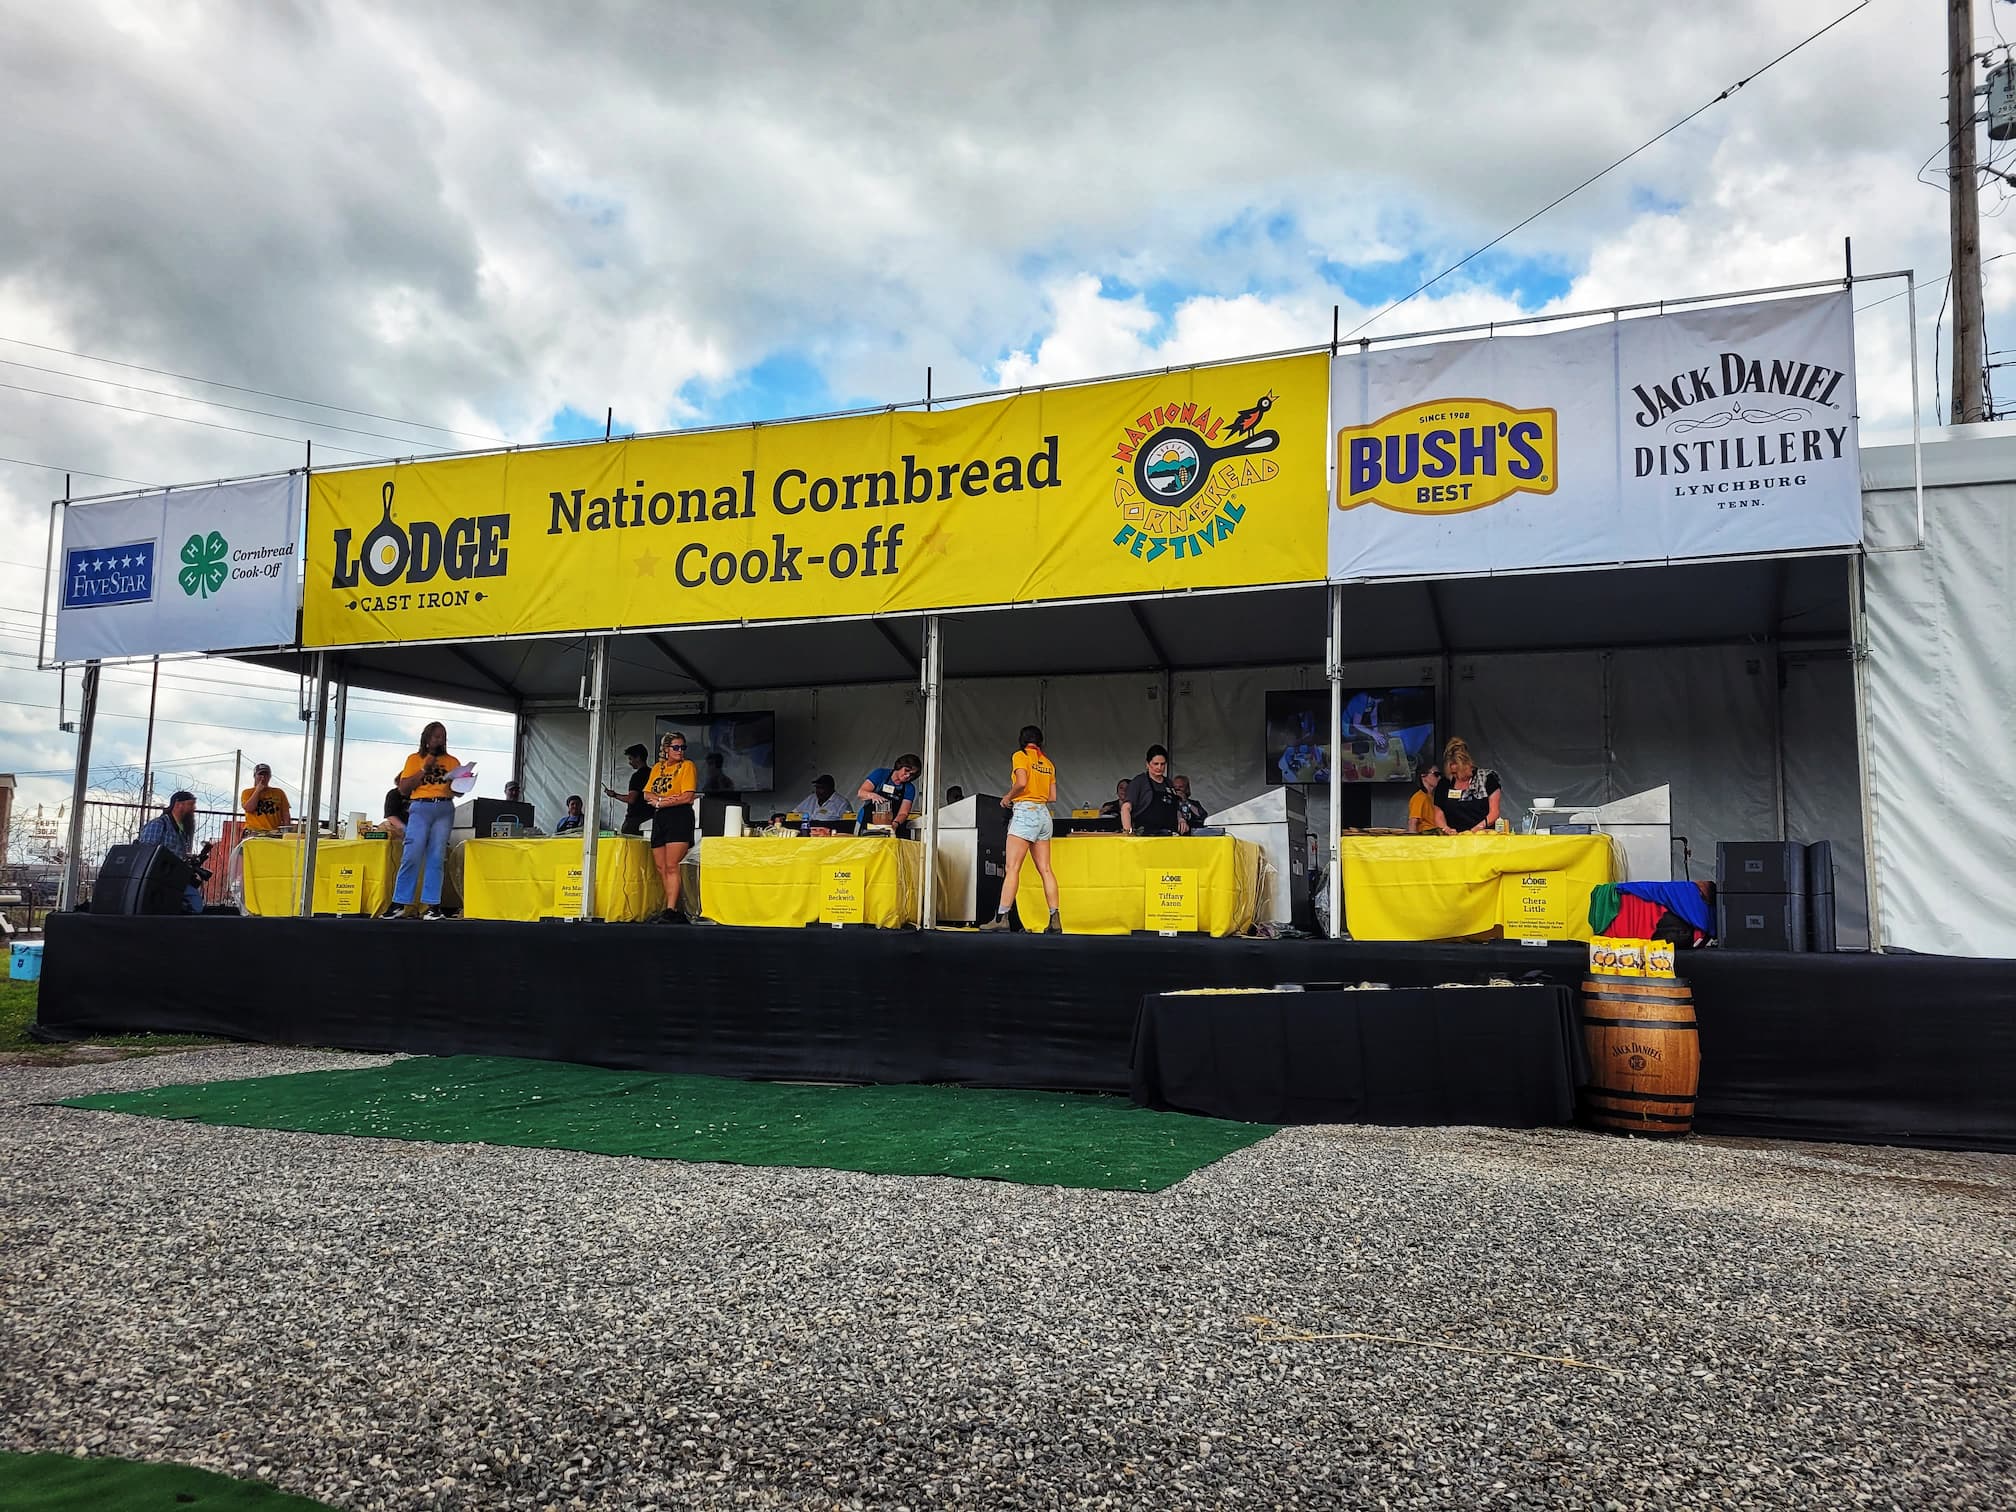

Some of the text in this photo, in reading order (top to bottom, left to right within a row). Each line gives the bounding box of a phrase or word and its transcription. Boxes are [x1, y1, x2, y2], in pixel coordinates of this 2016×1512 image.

[1631, 352, 1846, 428] JACK DANIEL
[1419, 411, 1470, 424] SINCE 1908
[1112, 401, 1224, 463] NATIONAL
[1350, 421, 1544, 496] BUSH'S
[1634, 426, 1848, 478] DISTILLERY
[547, 435, 1062, 535] National Cornbread
[1416, 483, 1473, 503] BEST
[1675, 475, 1807, 496] LYNCHBURG
[1113, 458, 1279, 534] CORNBREAD
[1717, 499, 1765, 510] TENN.
[1113, 500, 1246, 563] FESTIVAL
[232, 542, 294, 562] Cornbread
[331, 508, 511, 589] LODGE
[675, 523, 905, 588] Cook-off
[231, 562, 282, 580] Cook-Off
[360, 590, 470, 612] CAST IRON
[1159, 893, 1184, 901] Tiffany
[1522, 897, 1547, 905] Chera
[1523, 905, 1546, 913] Little
[1611, 1044, 1632, 1057] JACK
